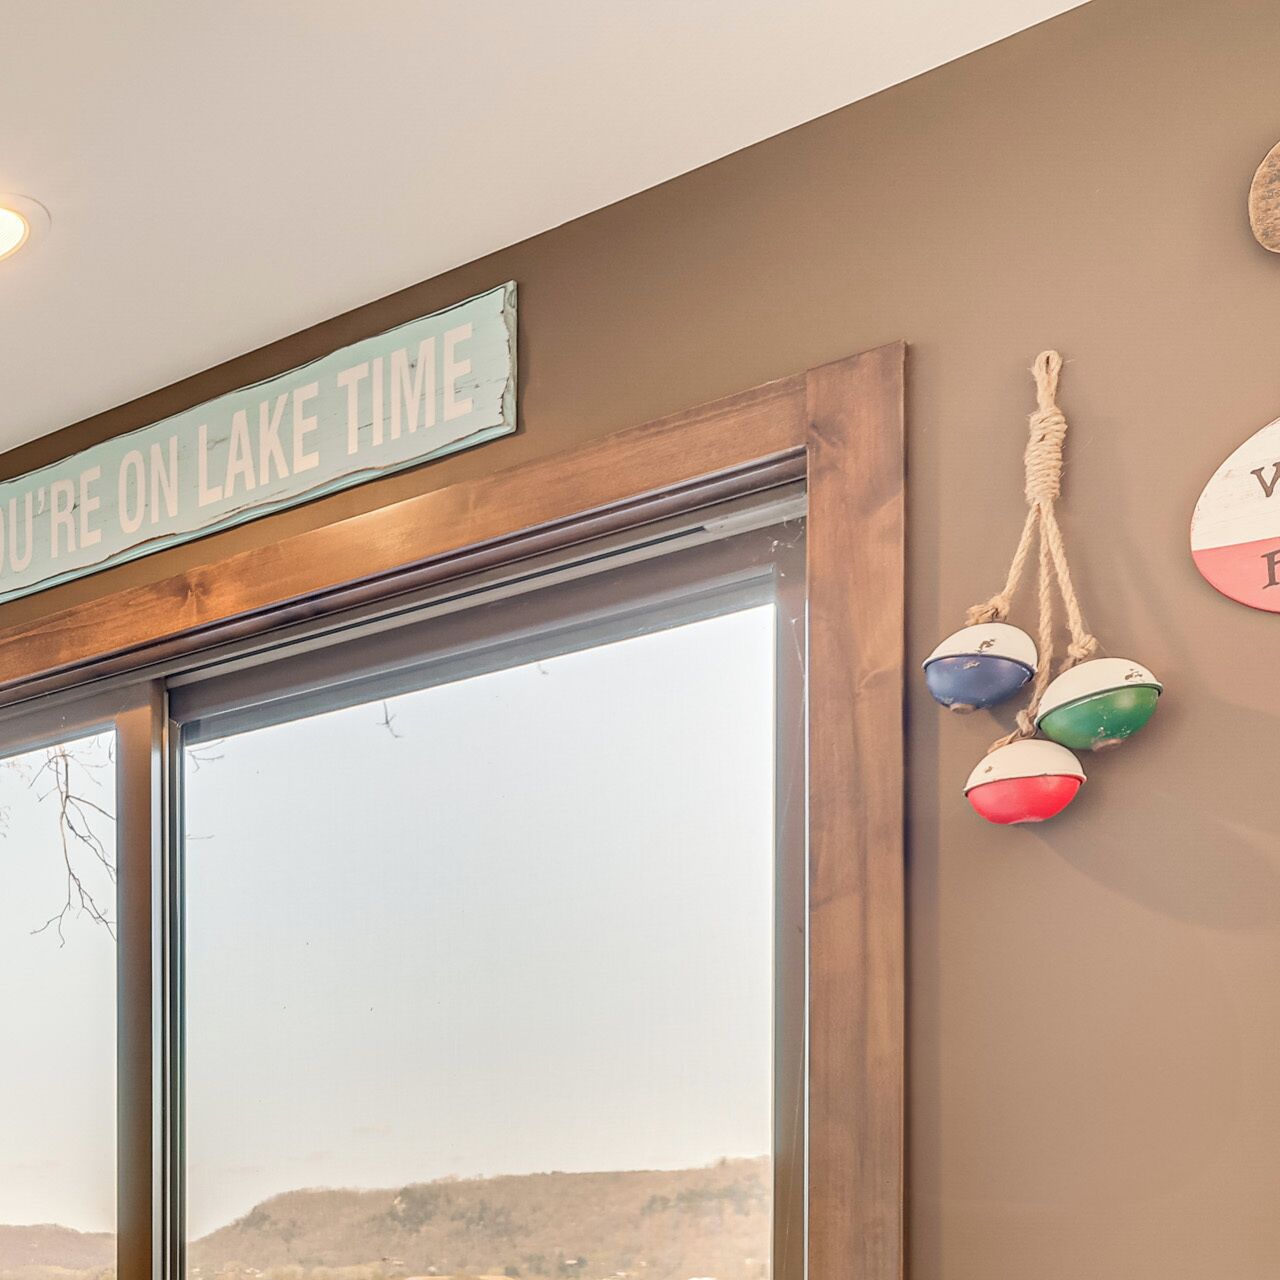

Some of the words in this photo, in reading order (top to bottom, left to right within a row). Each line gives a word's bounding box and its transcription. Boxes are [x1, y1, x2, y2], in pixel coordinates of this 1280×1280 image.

[117, 434, 179, 534] ON
[197, 380, 320, 509] LAKE
[336, 321, 473, 456] TIME
